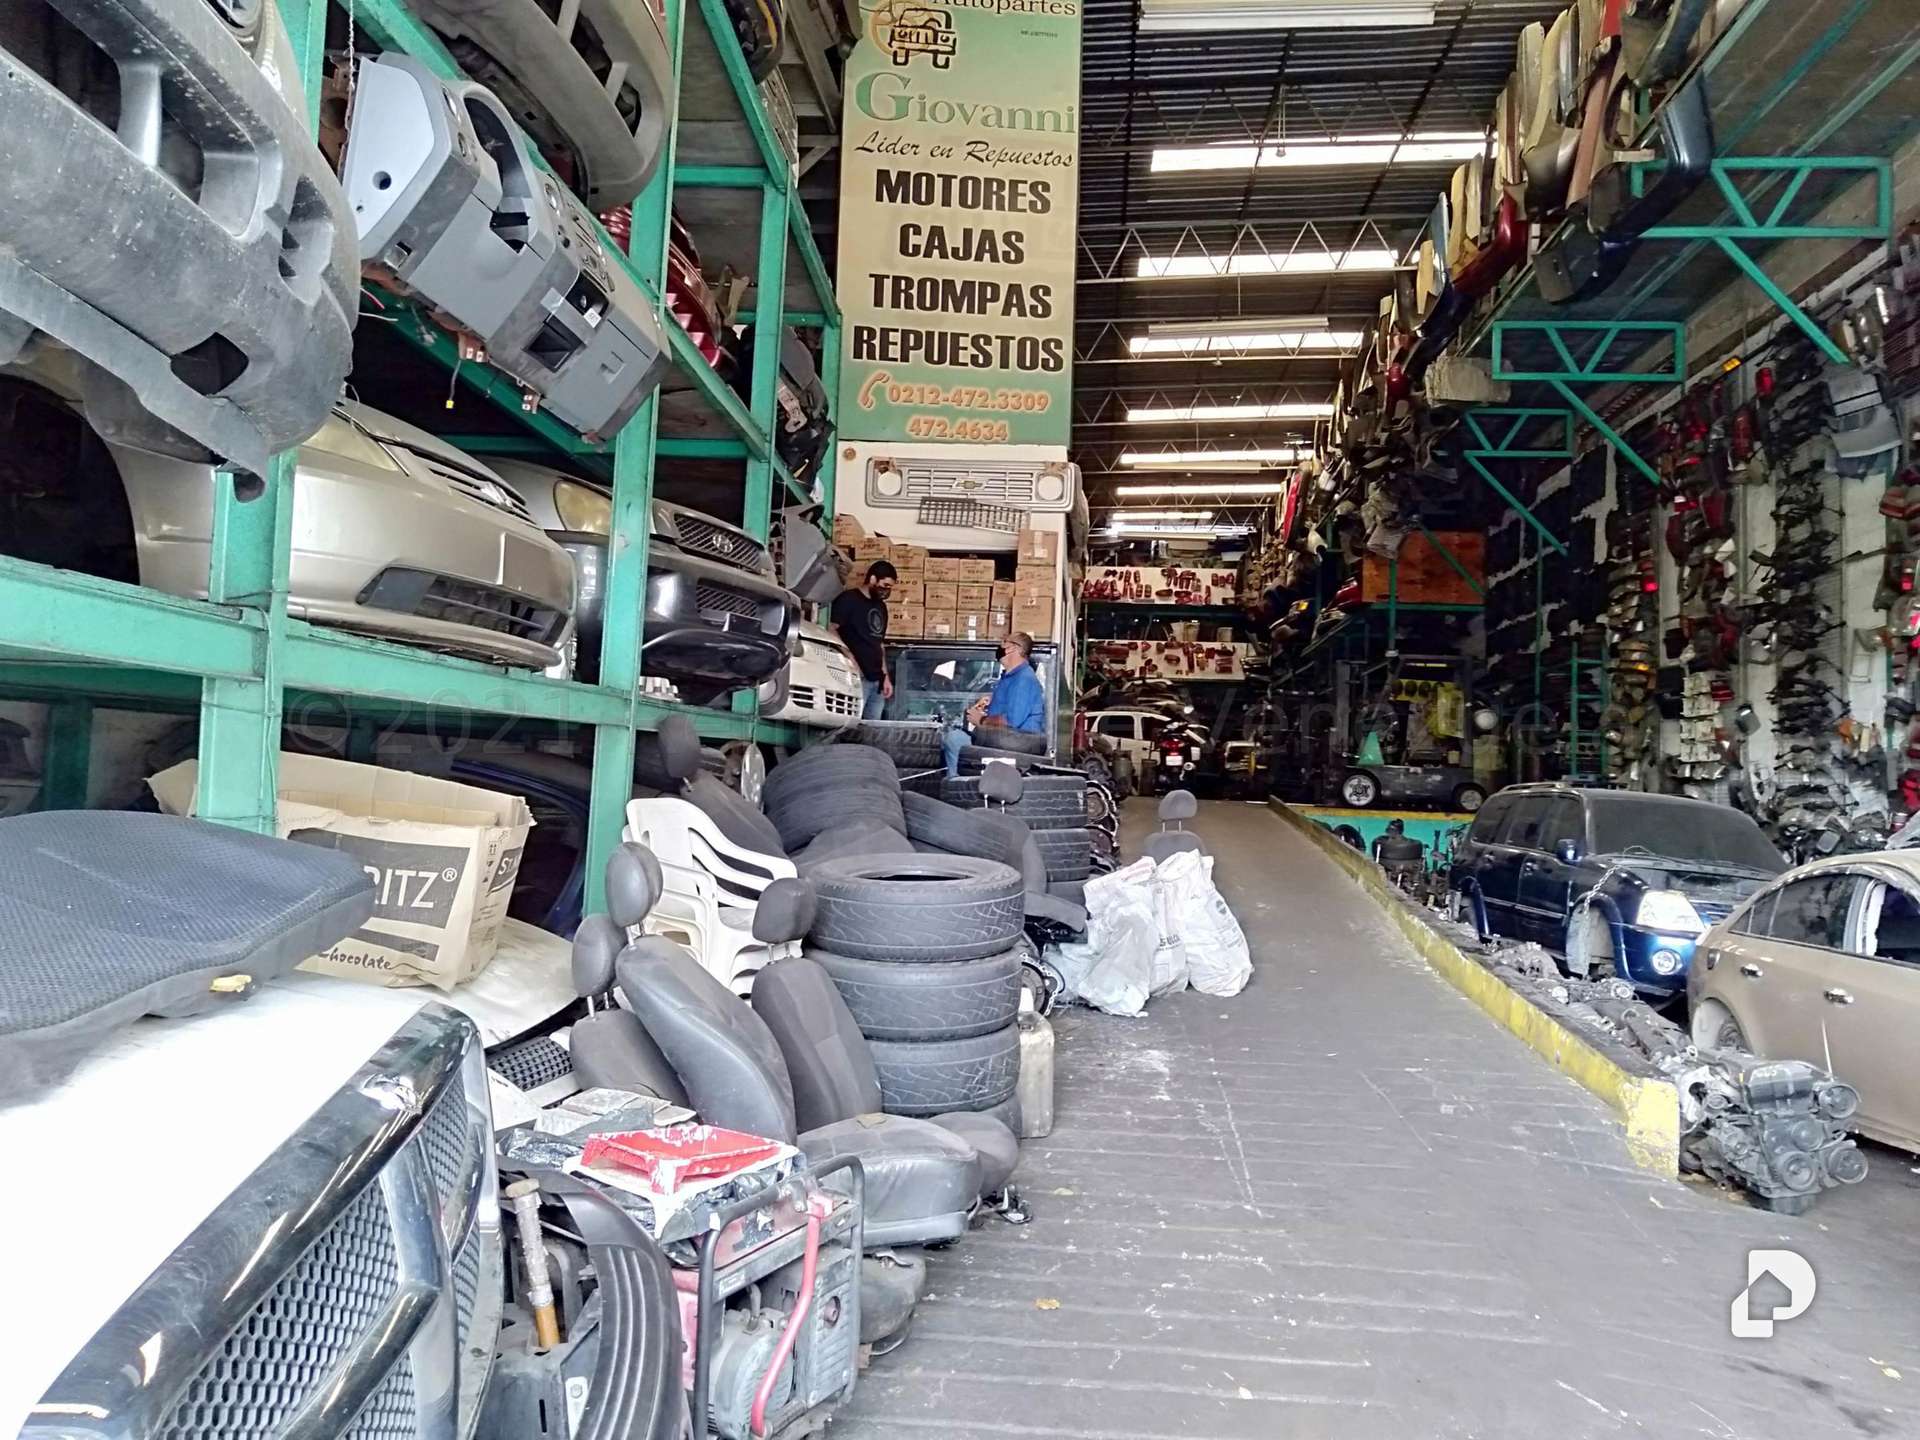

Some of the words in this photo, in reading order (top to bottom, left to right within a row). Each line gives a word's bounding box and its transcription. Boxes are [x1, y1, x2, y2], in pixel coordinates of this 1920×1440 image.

[932, 0, 1077, 16] utopartes
[855, 71, 1076, 134] Giovanni
[930, 145, 953, 158] en
[963, 140, 1074, 168] Repuestos
[875, 168, 1051, 214] MOTORES
[899, 223, 1025, 265] CAJAS
[869, 273, 1052, 318] TROMPAS
[853, 325, 1064, 373] REPUESTOS
[888, 385, 1050, 412] 0212-472.3309
[908, 417, 1009, 441] 472.4634
